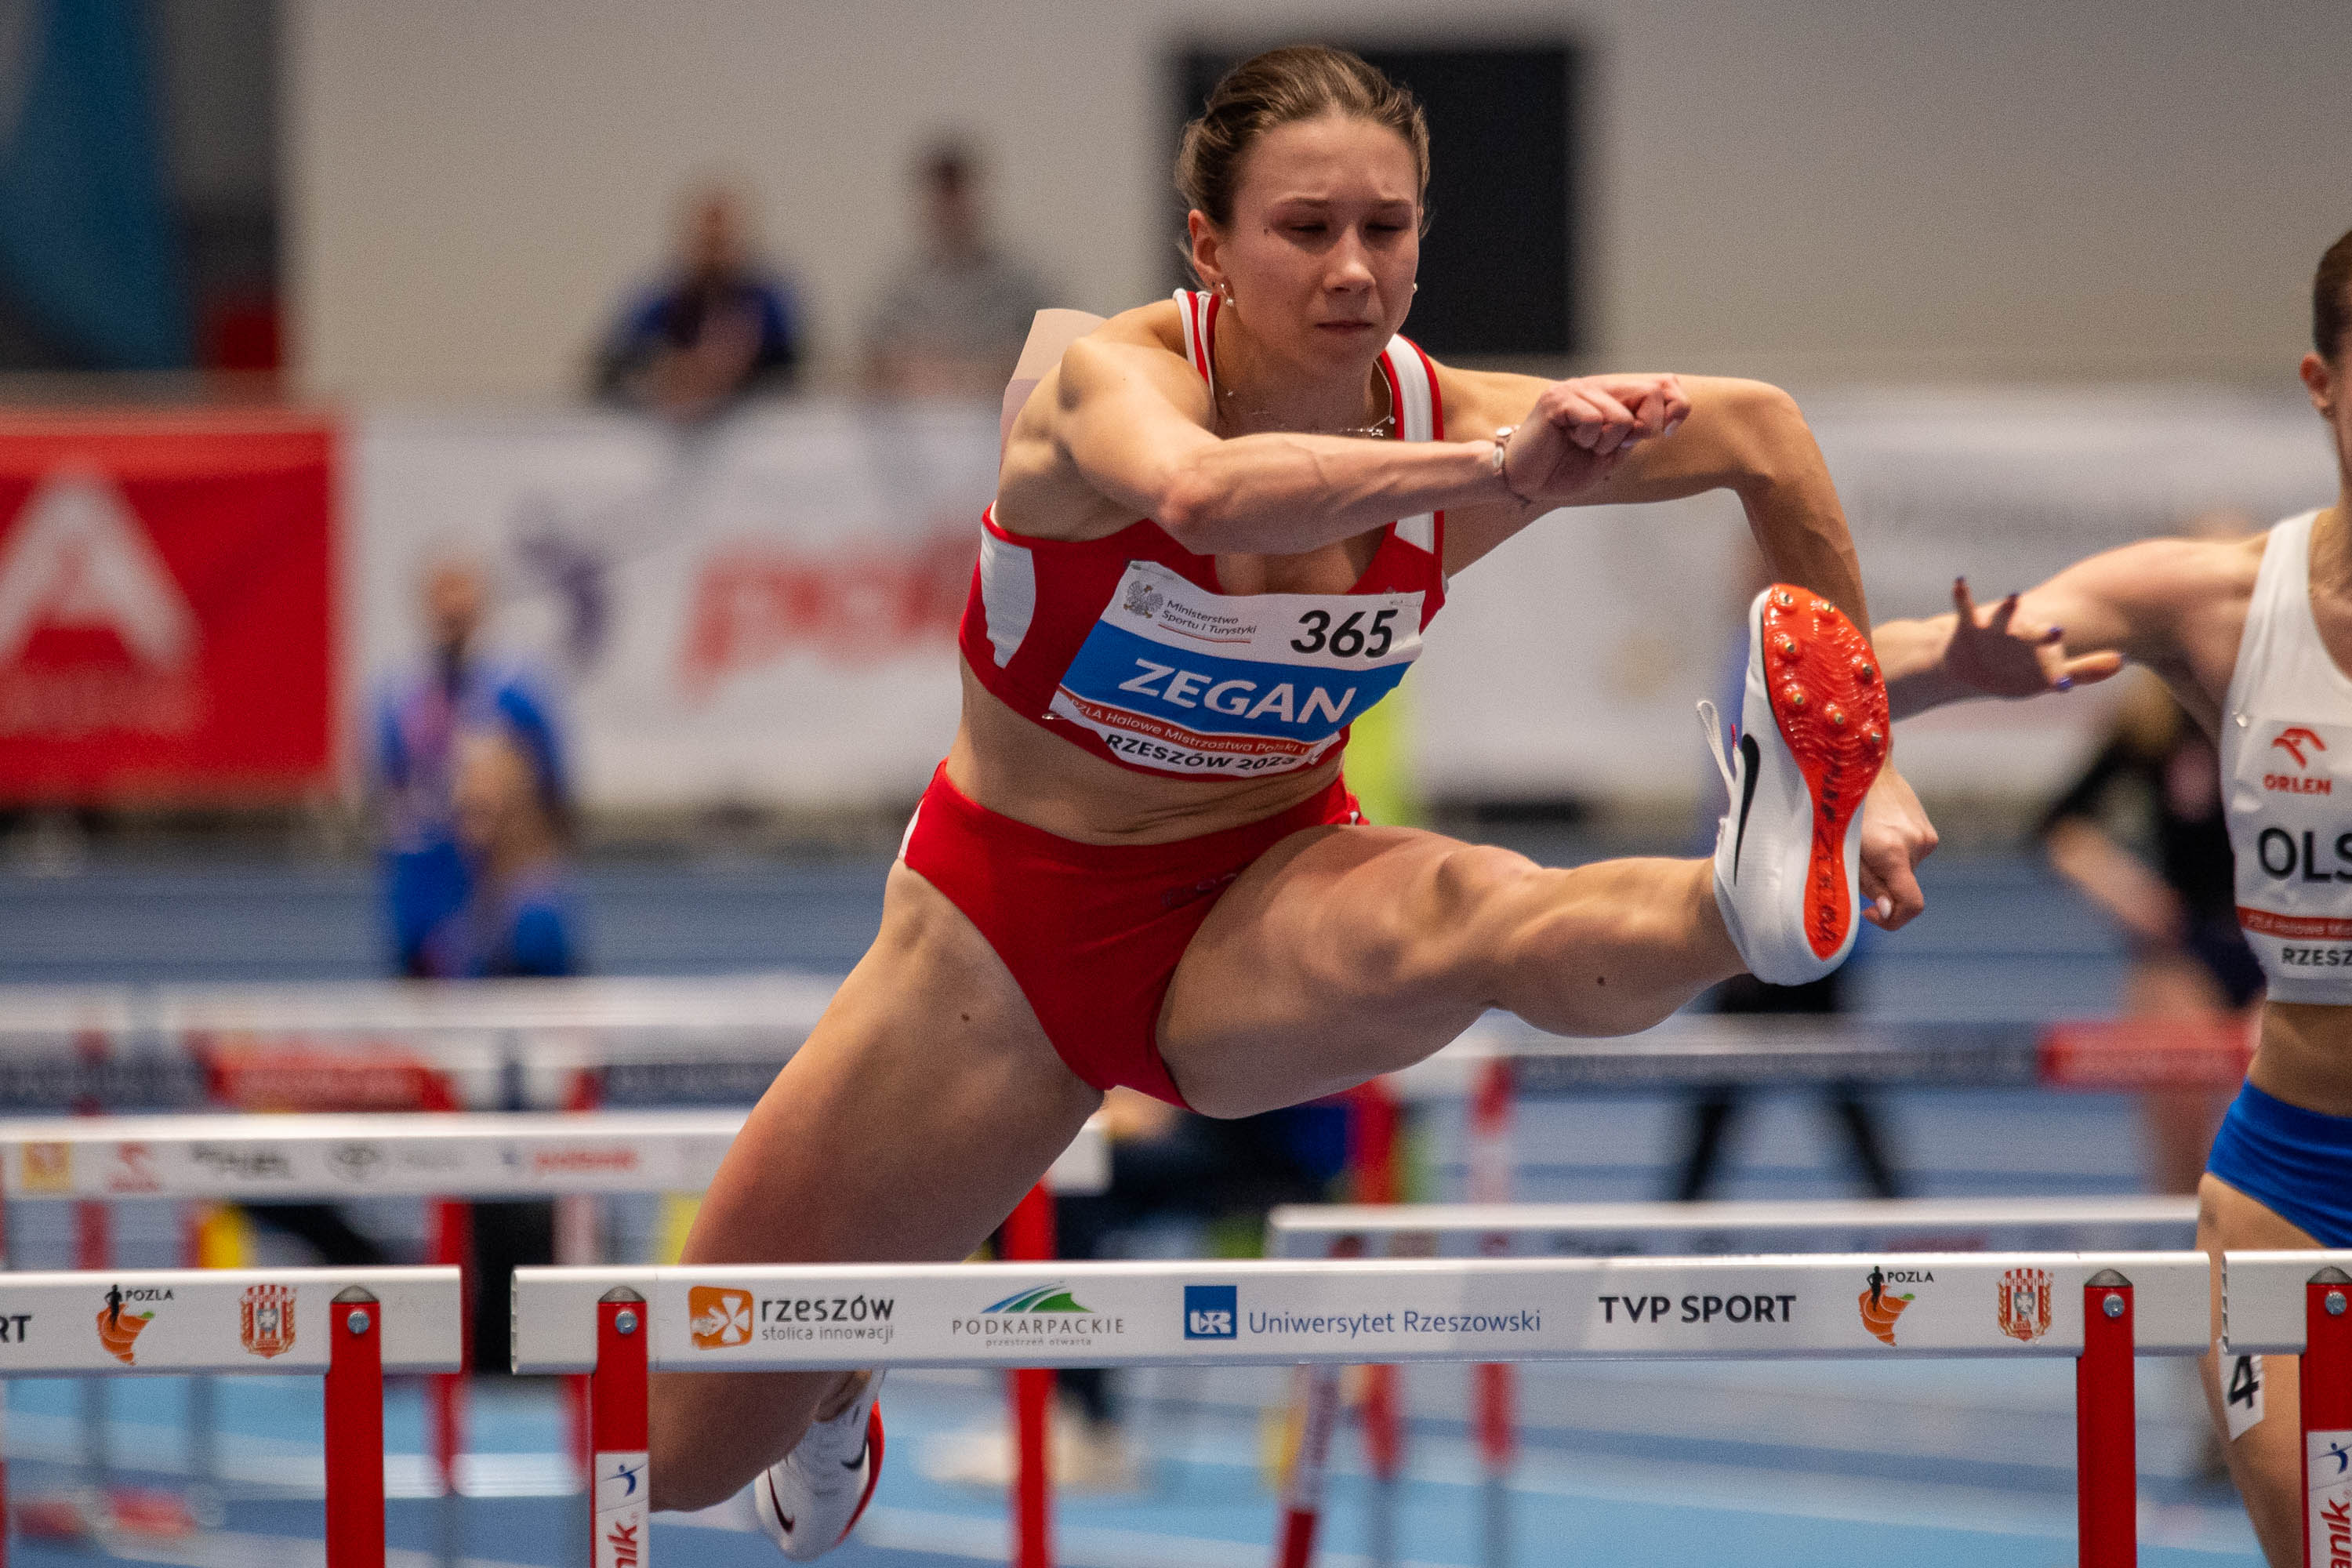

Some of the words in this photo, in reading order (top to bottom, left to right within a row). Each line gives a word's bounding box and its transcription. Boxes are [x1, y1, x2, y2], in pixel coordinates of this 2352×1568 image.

[1161, 611, 1200, 631] Sportu
[1209, 624, 1256, 637] Turystyki
[1167, 599, 1239, 625] Ministerstwo
[1290, 609, 1398, 659] 365
[1118, 658, 1357, 724] ZEGAN
[1106, 711, 1162, 735] Halowe
[1165, 728, 1253, 752] Mistrzostwa
[1105, 734, 1233, 768] RZESZÓW
[1236, 755, 1298, 771] 2023
[2263, 774, 2332, 795] ORLEN
[2258, 827, 2352, 884] OLS
[1887, 1271, 1934, 1283] POZLA
[125, 1290, 174, 1301] POZLA
[762, 1294, 895, 1323] rzeszów
[1599, 1295, 1671, 1323] TVP
[1681, 1294, 1797, 1323] SPORT
[762, 1325, 813, 1341] stolica
[819, 1326, 895, 1345] innowacji
[953, 1319, 1124, 1335] PODKARPACKIE
[1249, 1311, 1396, 1338] Uniwersytet
[1404, 1310, 1541, 1333] Rzeszowski
[1049, 1338, 1092, 1346] otwarta
[2227, 1354, 2259, 1409] 4
